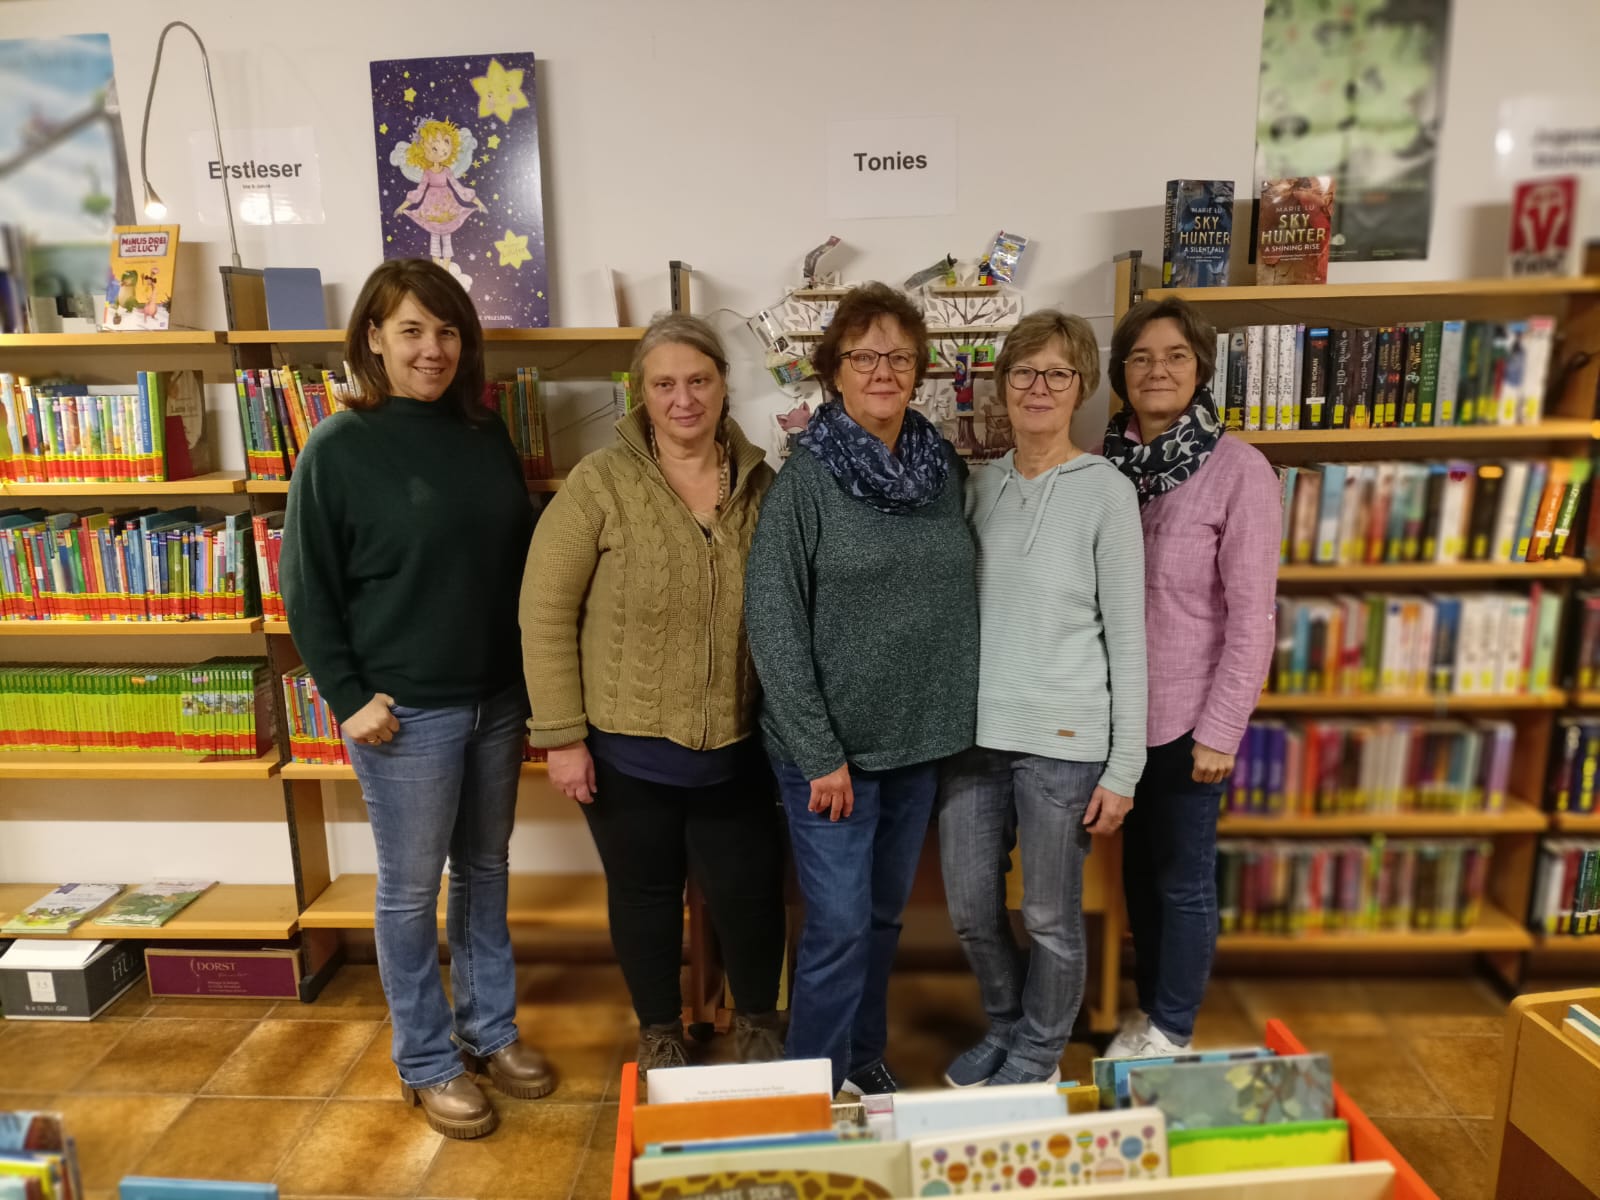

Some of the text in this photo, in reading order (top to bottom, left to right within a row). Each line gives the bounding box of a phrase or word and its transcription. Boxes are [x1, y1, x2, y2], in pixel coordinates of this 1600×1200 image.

[853, 151, 928, 171] Tonies
[208, 160, 302, 179] Erstleser
[1194, 216, 1219, 230] SKY
[1279, 213, 1310, 228] SKY
[121, 236, 167, 245] MINUS DREI
[1180, 231, 1230, 245] HUNTER
[1261, 227, 1326, 245] HUNTER
[137, 245, 160, 253] LUCY
[1271, 244, 1303, 253] SHINING
[196, 961, 236, 971] DORST
